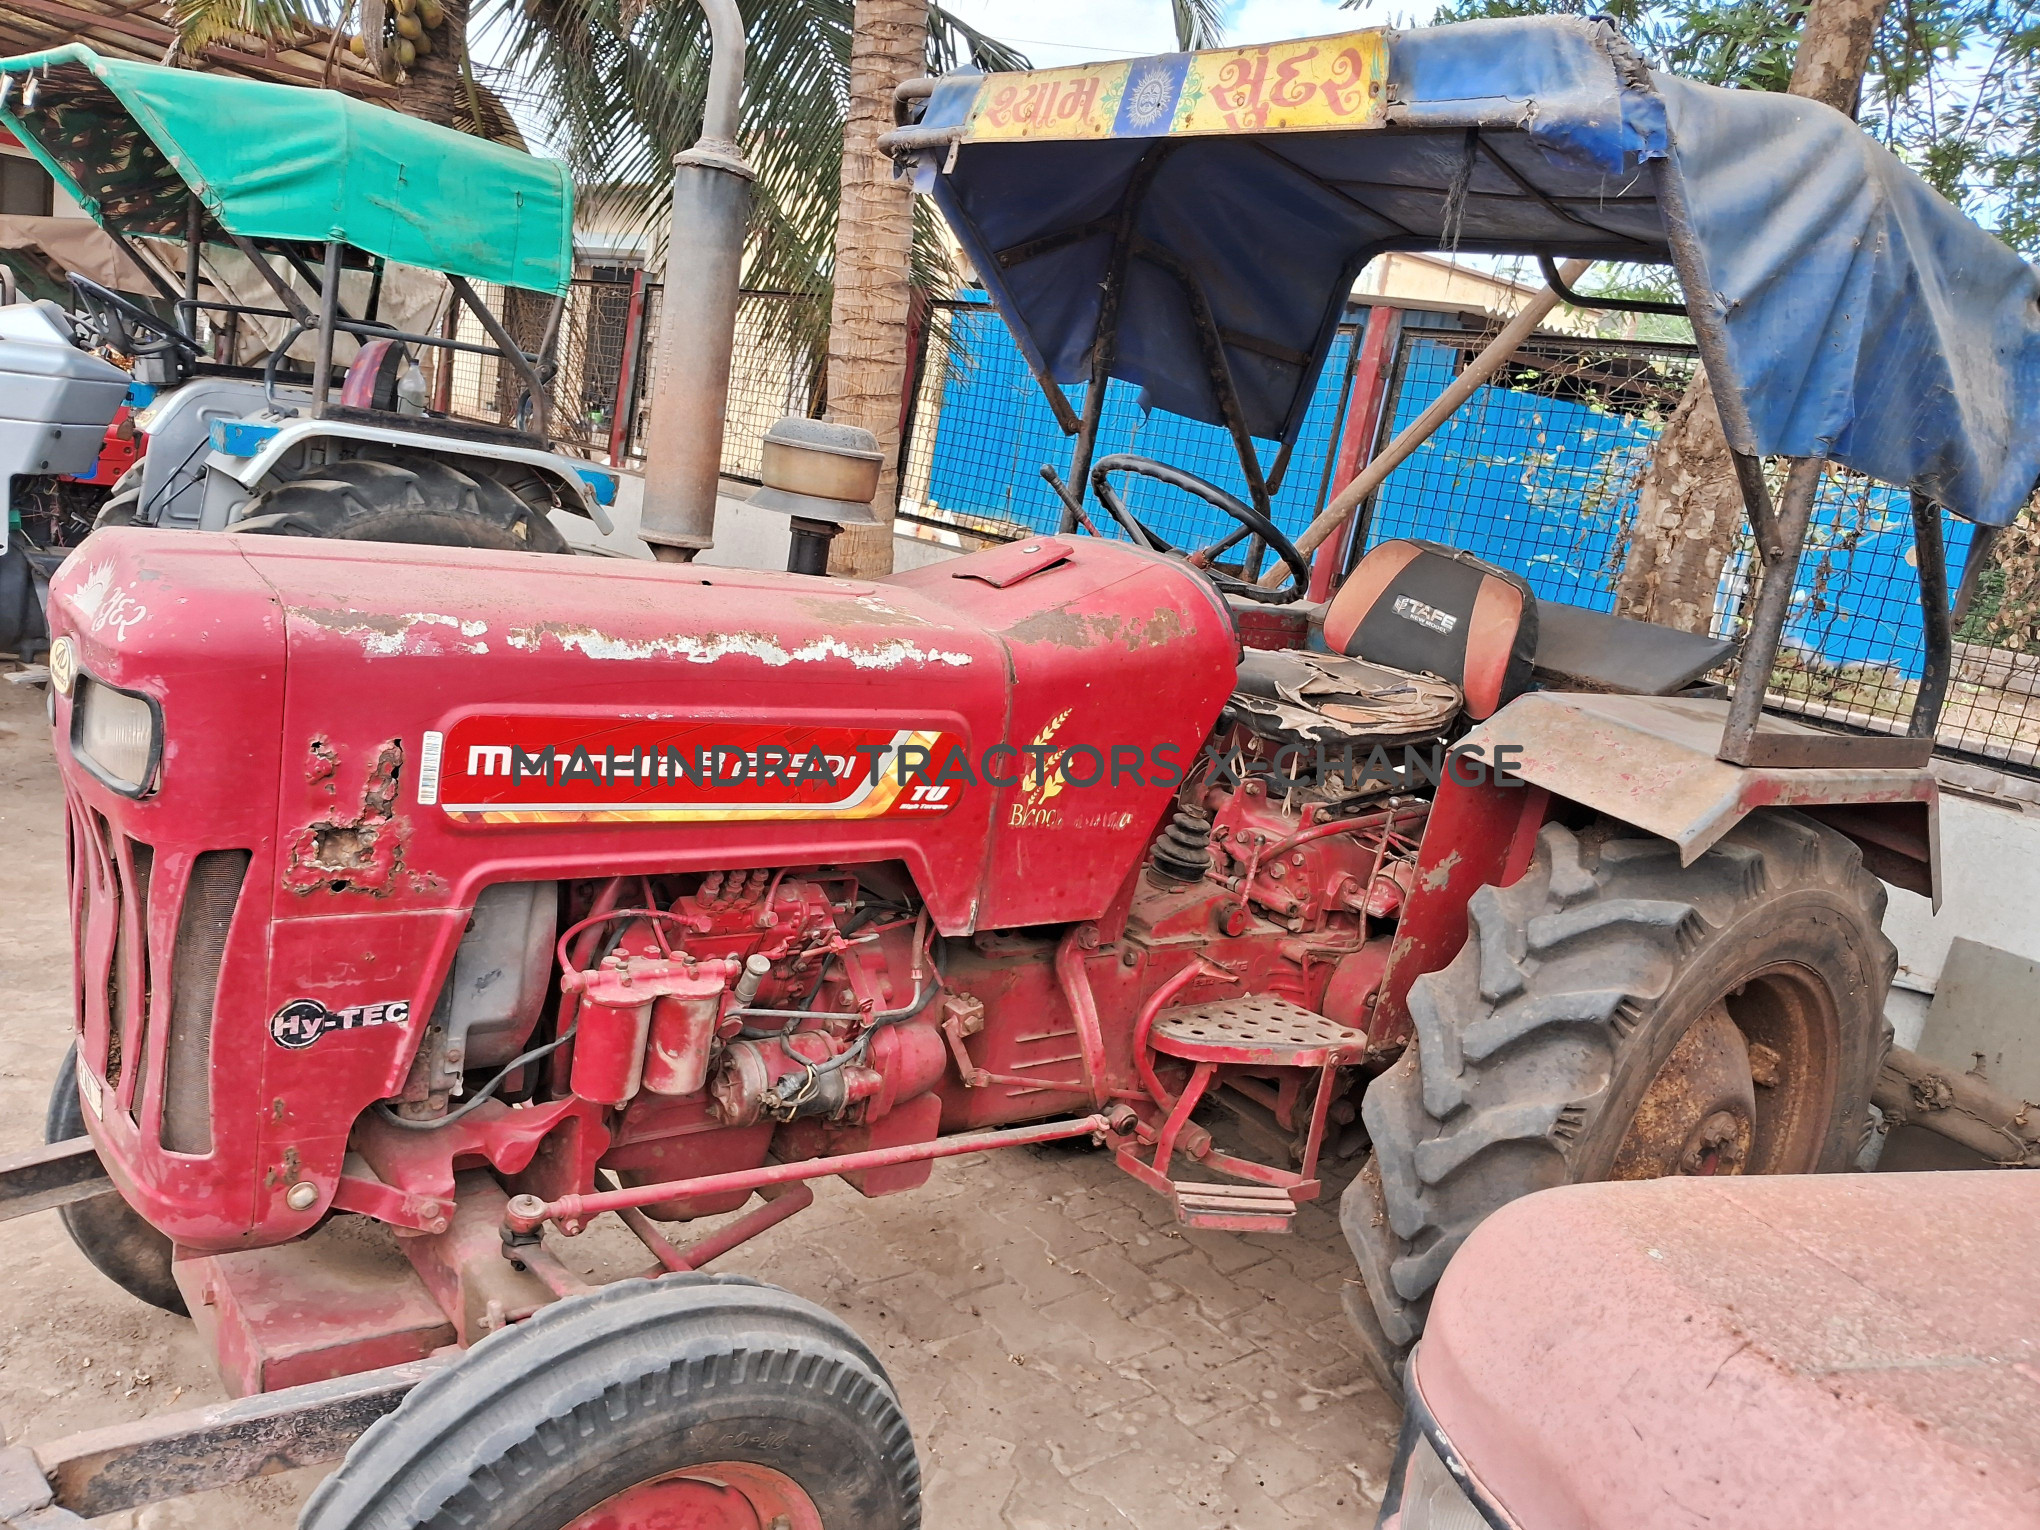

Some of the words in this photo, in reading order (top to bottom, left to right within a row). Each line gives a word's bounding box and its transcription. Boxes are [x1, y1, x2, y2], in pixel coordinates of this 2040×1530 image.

[985, 77, 1100, 129] શ્યામ
[1209, 46, 1362, 131] સુંદર
[1408, 598, 1458, 631] TAFE
[1409, 613, 1426, 624] NEW
[1425, 620, 1447, 634] MODEL
[911, 785, 950, 802] TU
[273, 1002, 408, 1039] Hy-TEC
